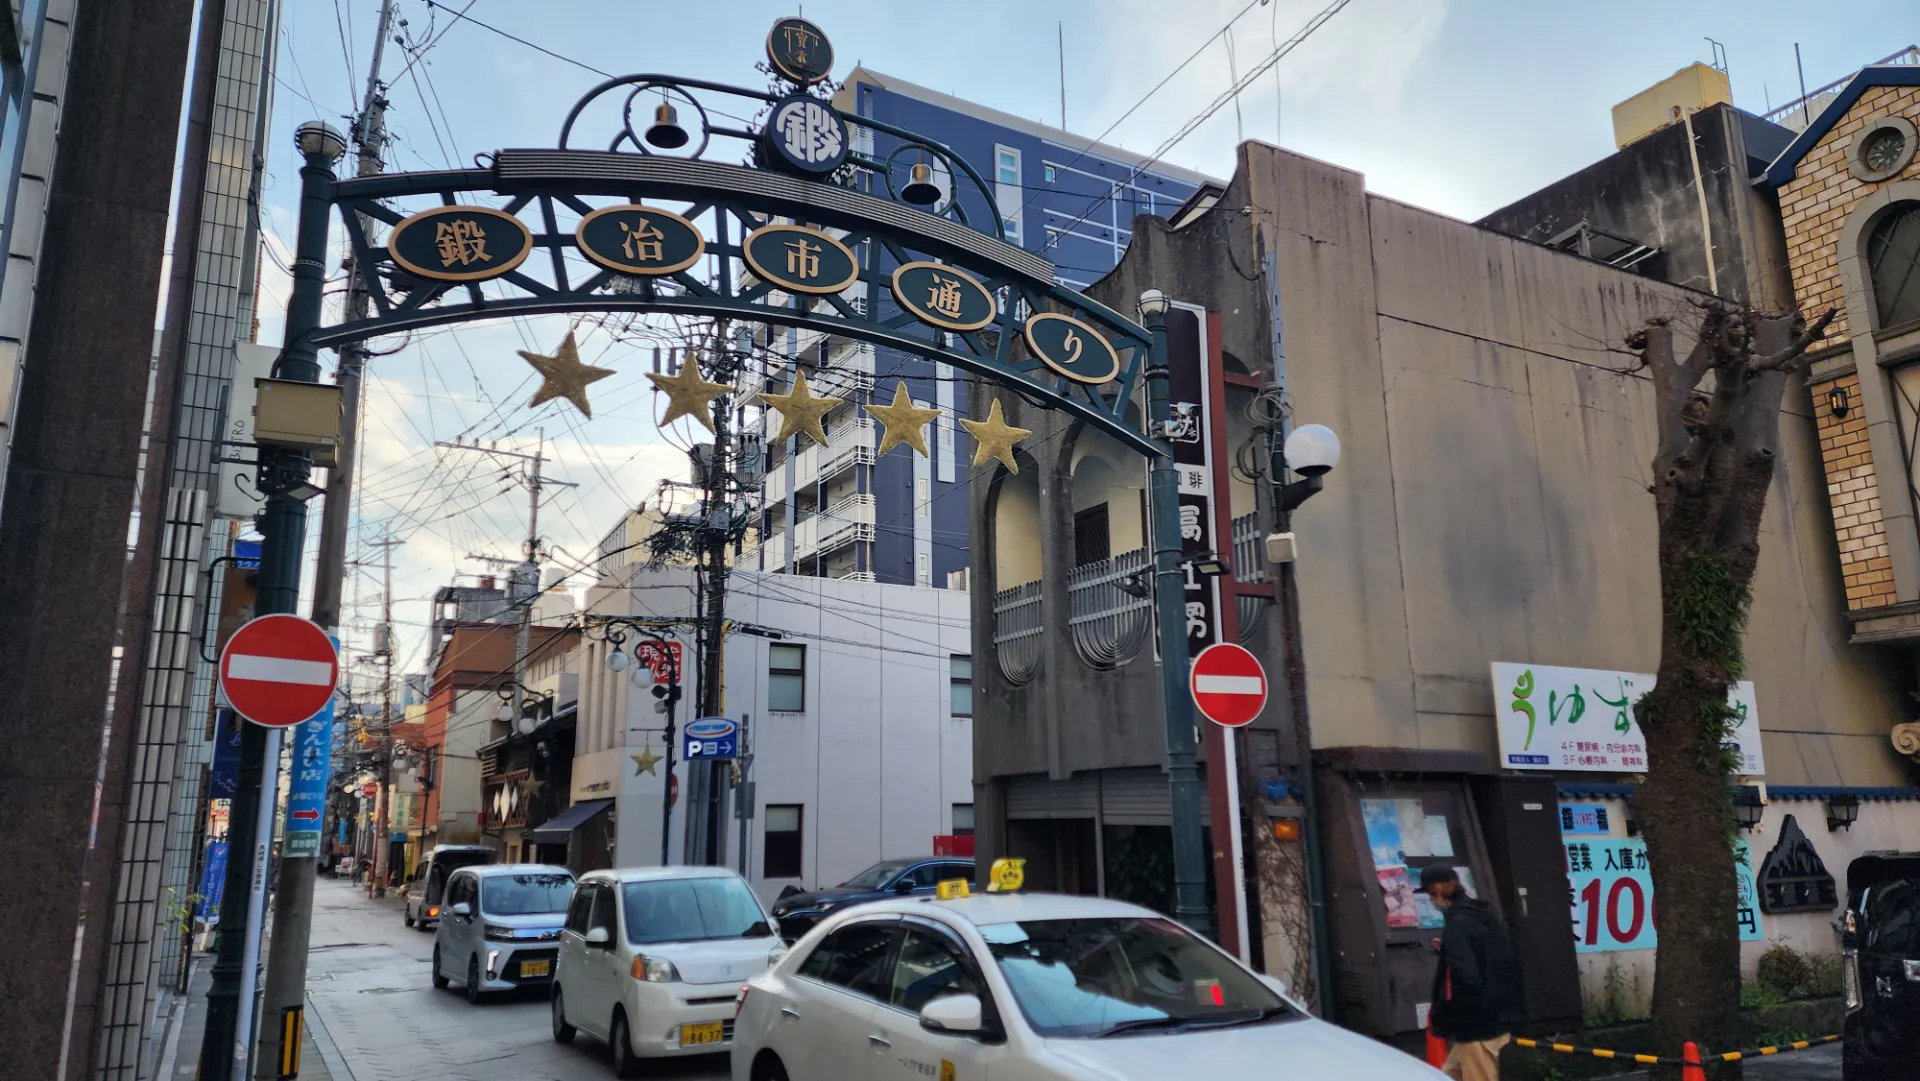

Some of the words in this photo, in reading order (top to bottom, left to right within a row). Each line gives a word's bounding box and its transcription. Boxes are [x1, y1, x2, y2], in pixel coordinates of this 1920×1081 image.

[434, 217, 1085, 366] 鍛冶市通り
[229, 419, 245, 460] BITRO
[688, 740, 702, 757] P
[690, 1030, 722, 1045] 84-37
